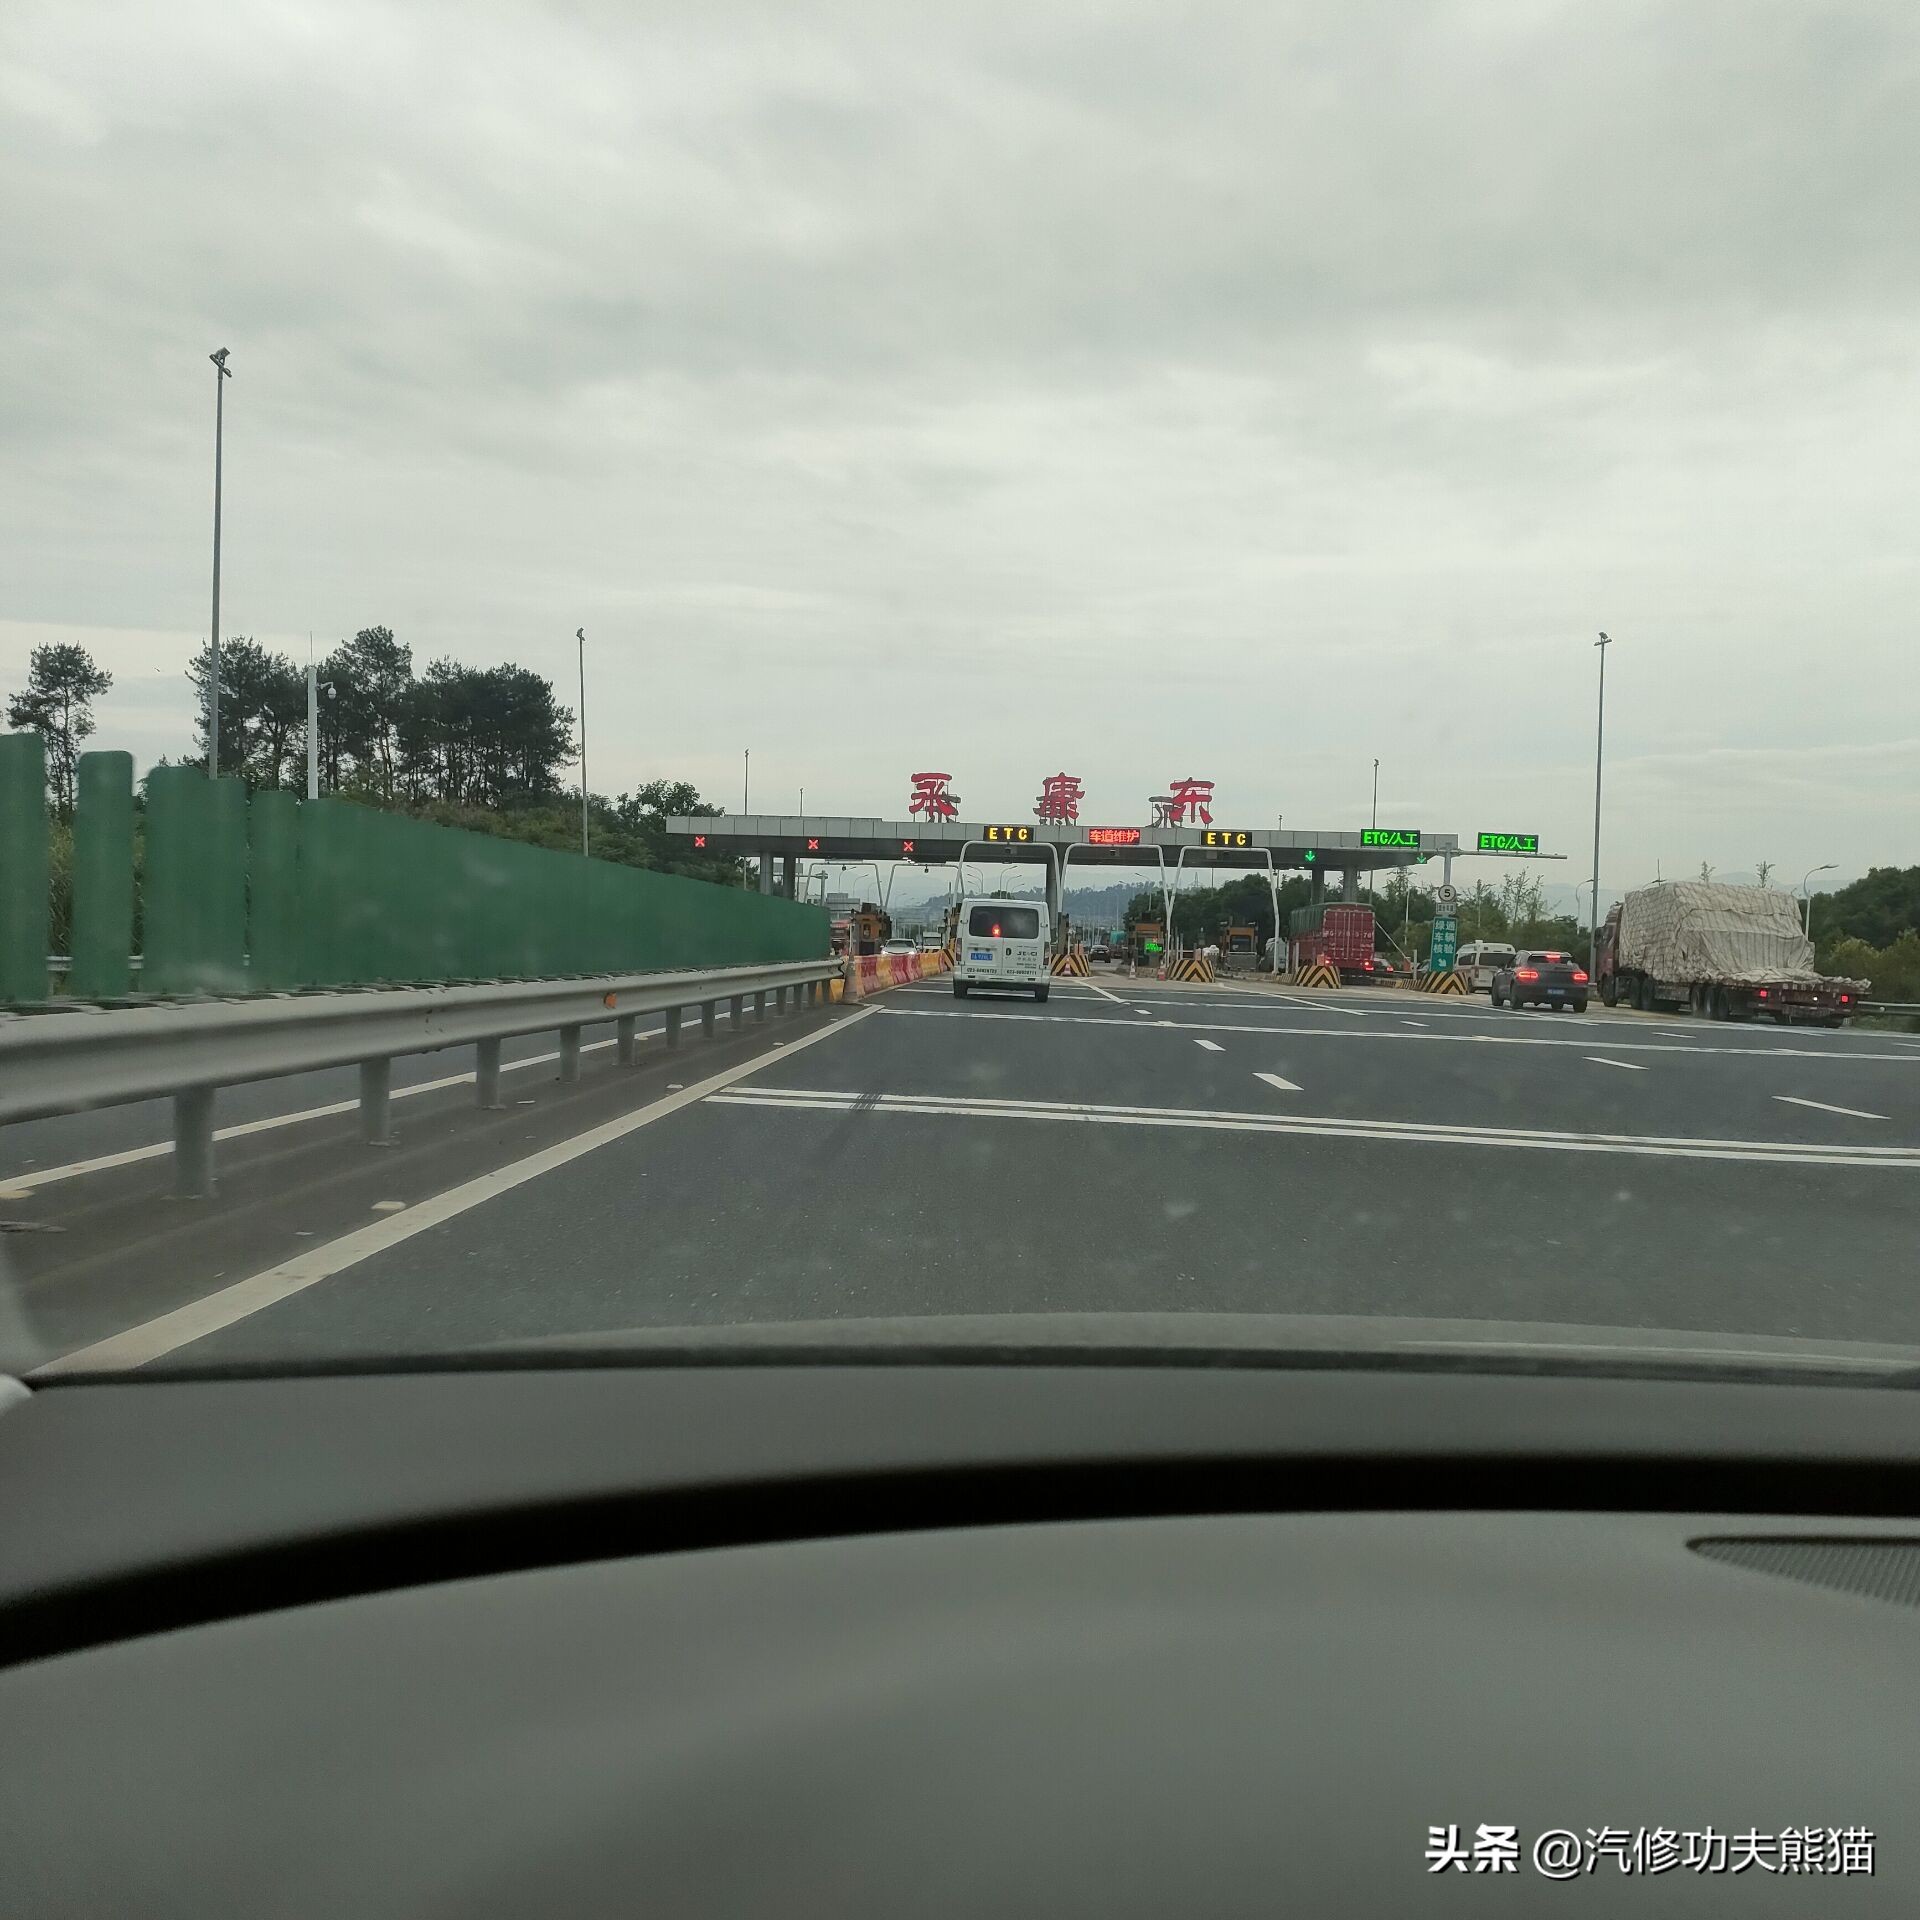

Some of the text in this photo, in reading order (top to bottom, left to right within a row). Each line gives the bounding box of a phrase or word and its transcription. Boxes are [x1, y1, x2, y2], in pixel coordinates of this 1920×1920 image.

[989, 828, 1028, 840] ETC
[1089, 829, 1140, 843] 车道维护
[1207, 833, 1246, 845] ETC
[1364, 831, 1419, 846] ETC/人工
[1481, 834, 1536, 850] ETC/人工
[1444, 889, 1451, 898] 5
[1434, 932, 1455, 942] 车辆
